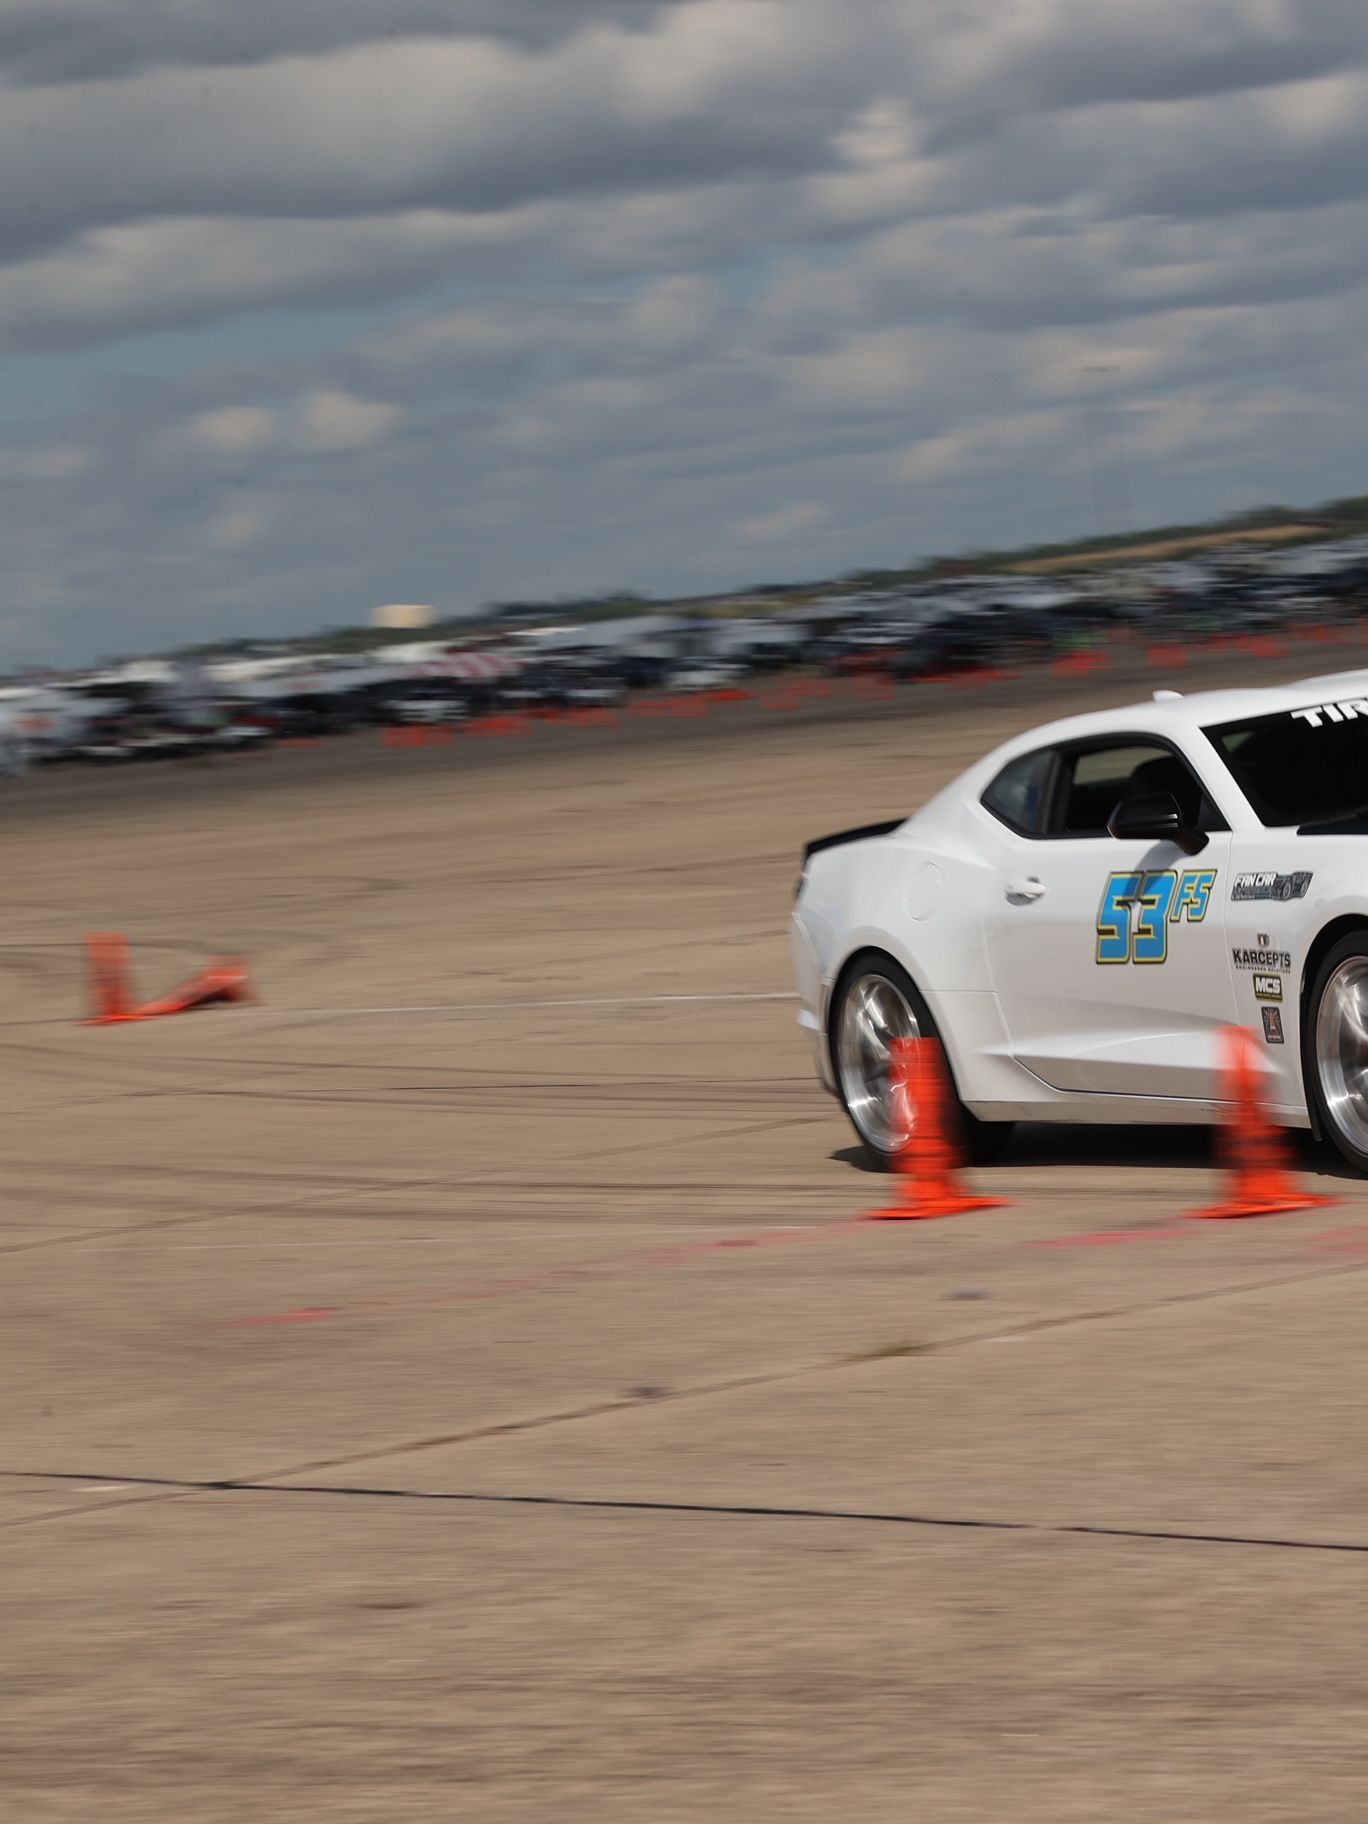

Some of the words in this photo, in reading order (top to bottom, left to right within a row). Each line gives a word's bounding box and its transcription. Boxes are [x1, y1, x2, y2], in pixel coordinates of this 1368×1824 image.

[1235, 874, 1257, 888] FAN
[1255, 872, 1276, 887] CAR
[1095, 870, 1178, 964] 53
[1169, 869, 1218, 922] FS
[1232, 949, 1291, 968] KARCEPTS
[1255, 976, 1281, 994] MCS
